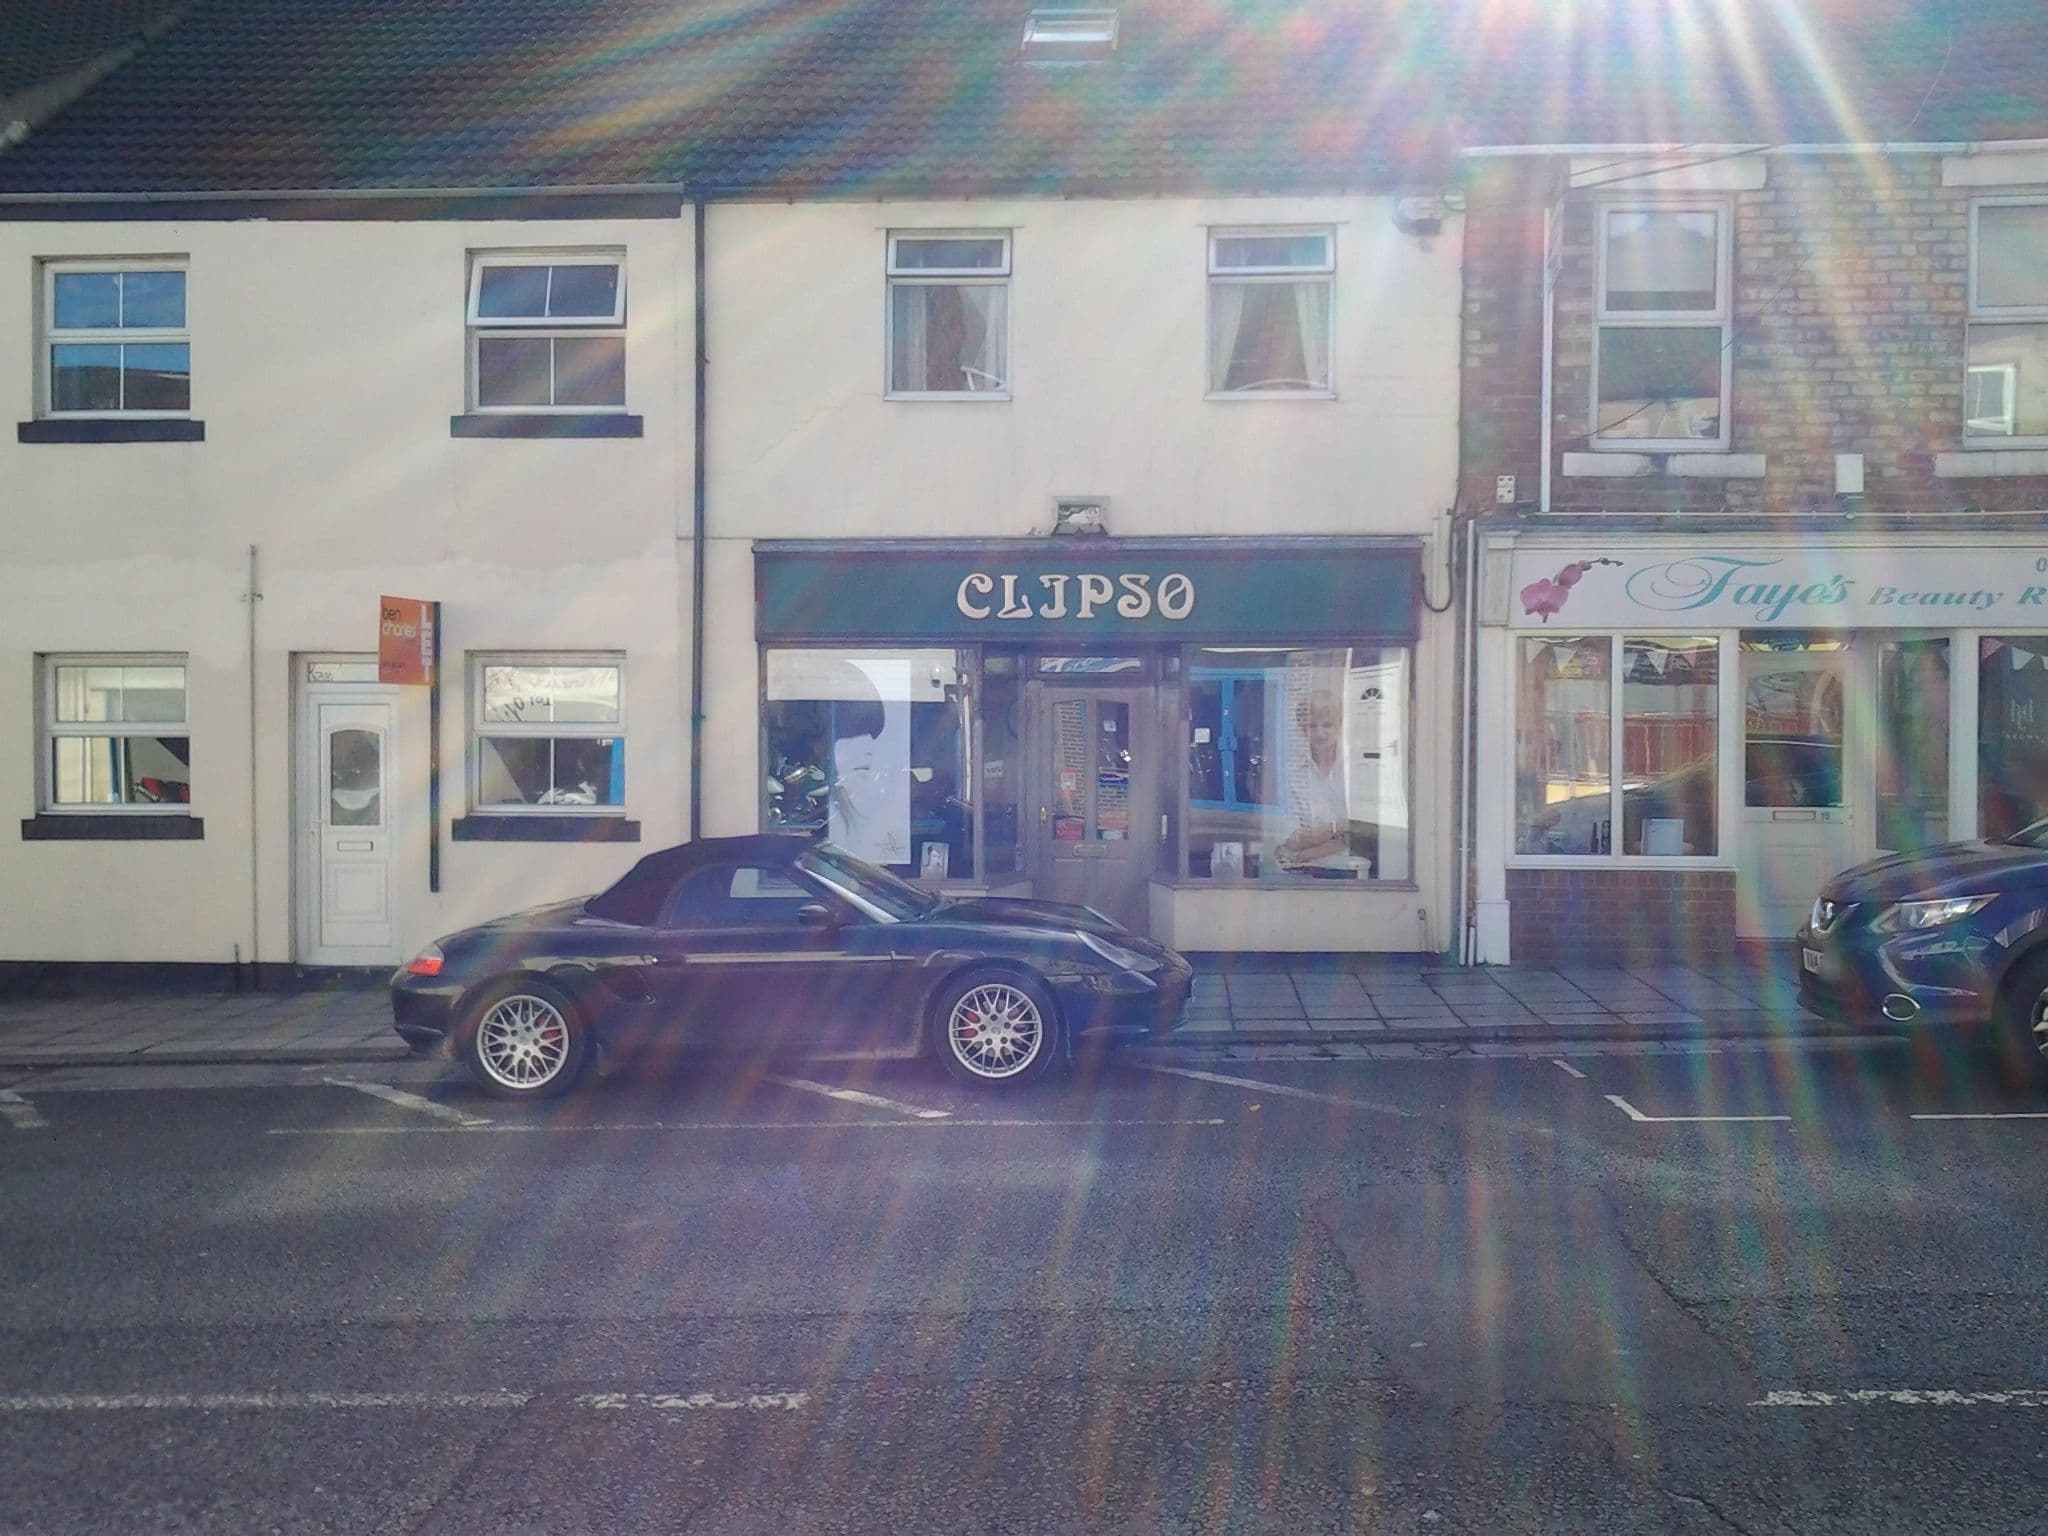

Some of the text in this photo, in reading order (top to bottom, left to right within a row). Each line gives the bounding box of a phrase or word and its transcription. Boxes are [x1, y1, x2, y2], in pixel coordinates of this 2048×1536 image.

[957, 573, 1195, 619] CLIPSO
[1625, 556, 1855, 622] Faye's
[1868, 586, 2004, 611] Beauty
